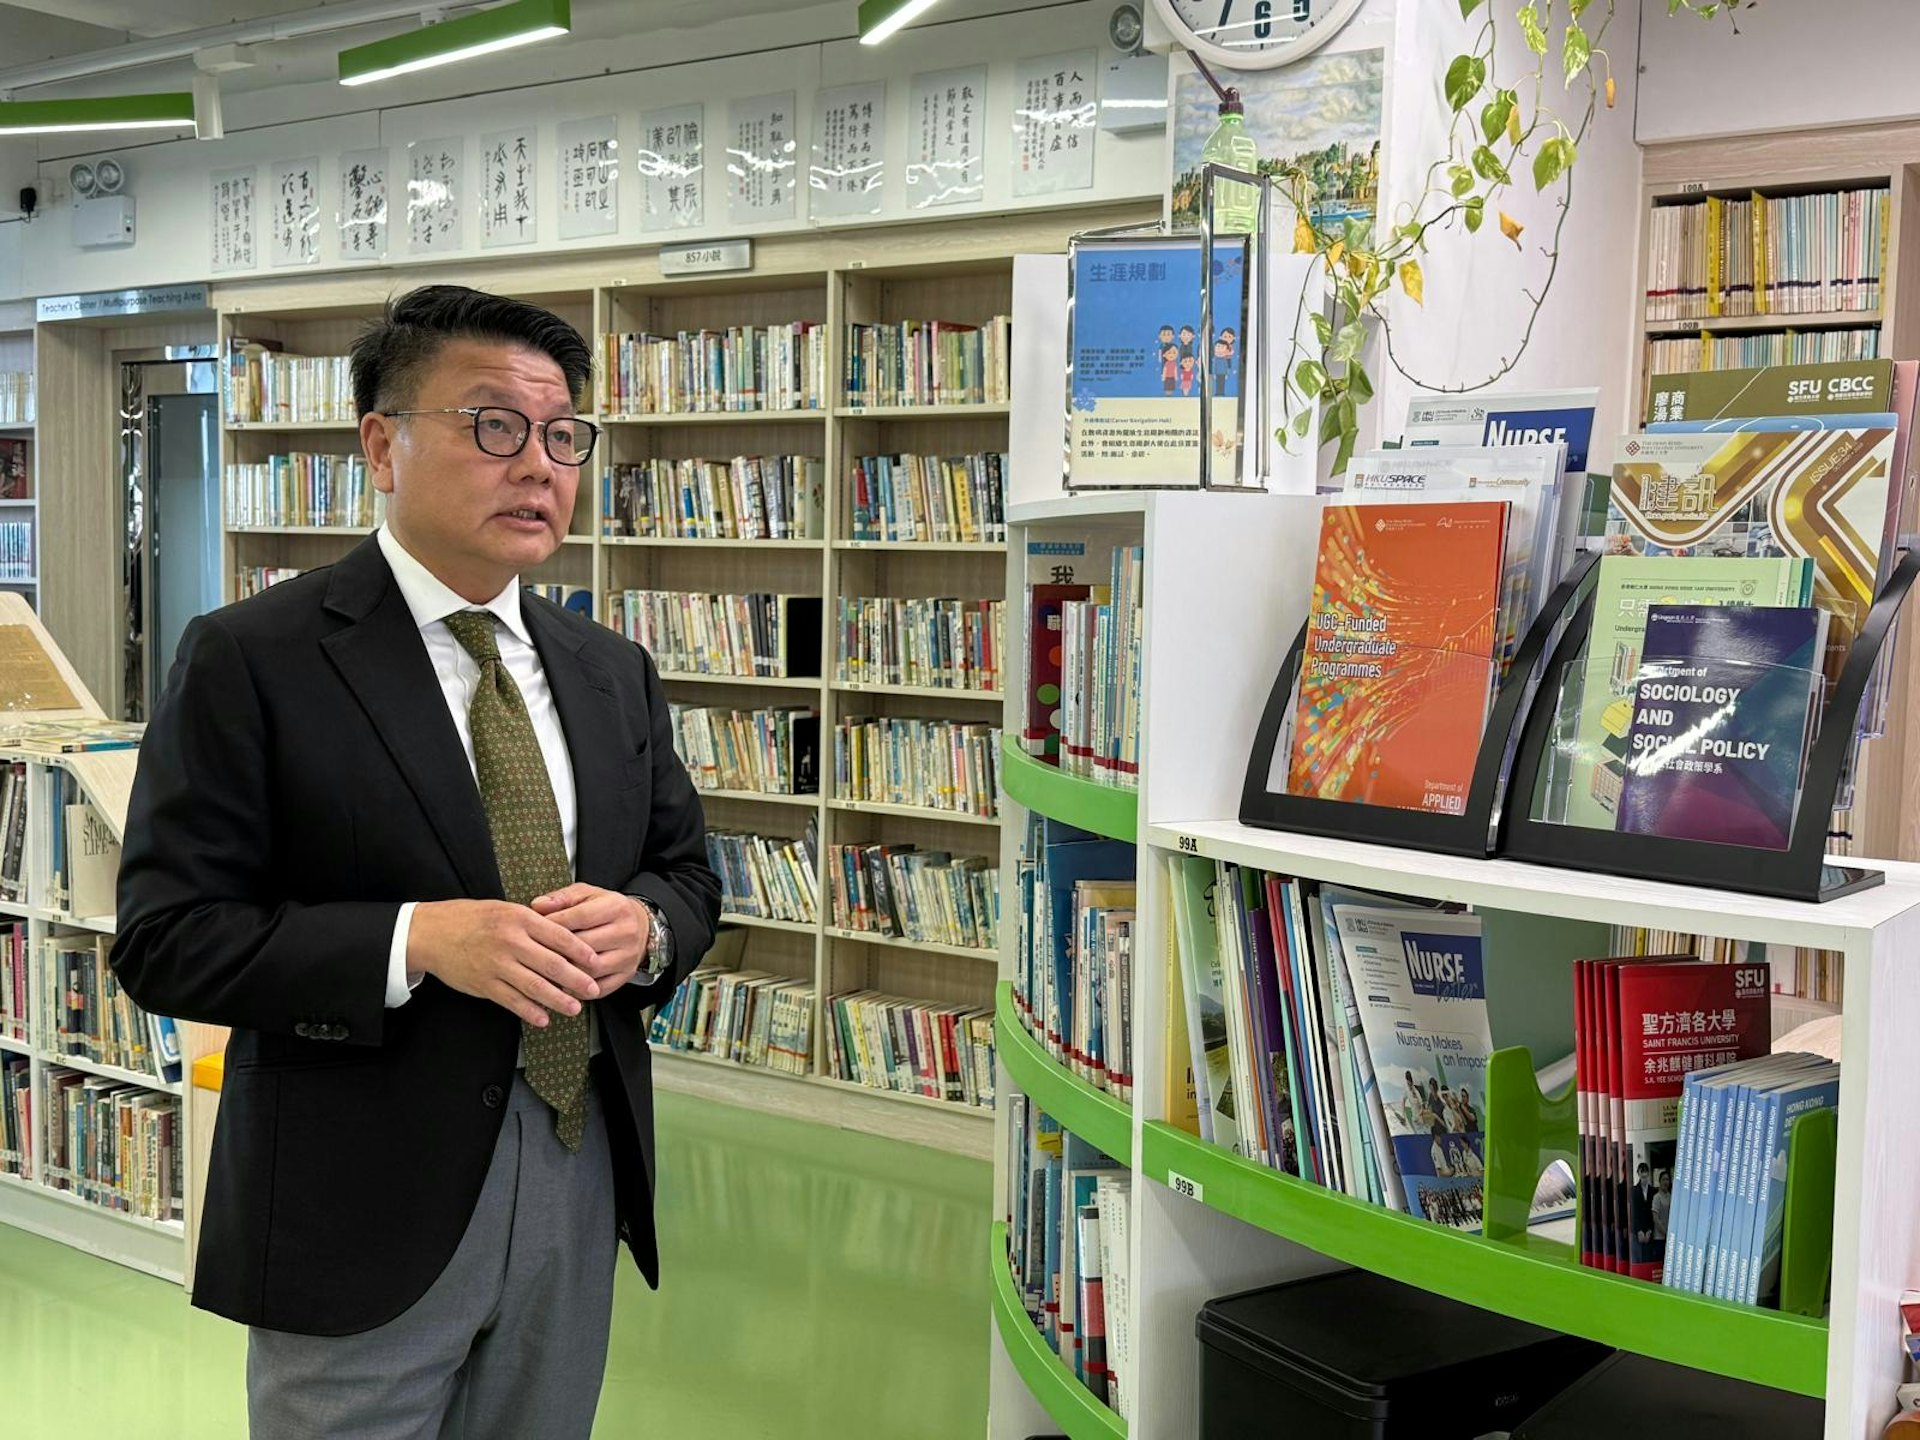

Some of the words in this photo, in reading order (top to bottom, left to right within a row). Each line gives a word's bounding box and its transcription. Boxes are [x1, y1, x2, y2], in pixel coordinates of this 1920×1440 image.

[1254, 1, 1271, 38] 6
[1089, 262, 1167, 282] 生涯規劃
[1788, 379, 1822, 396] SFU
[1828, 376, 1875, 393] CBCC
[1809, 452, 1840, 485] ISSUE
[1051, 565, 1075, 585] 我
[1316, 612, 1388, 633] UGC-Funded
[1314, 636, 1398, 657] Undergraduate
[1310, 658, 1382, 680] Programmes
[1697, 667, 1708, 678] of
[1639, 683, 1741, 704] SOCIOLOGY
[1636, 709, 1675, 726] AND
[1632, 733, 1696, 755] SOCI
[1701, 739, 1770, 761] POLICY
[1424, 779, 1457, 791] Department
[1422, 793, 1462, 811] APPLIED
[1178, 836, 1199, 853] 99A
[1404, 940, 1466, 983] NURSE
[1735, 968, 1765, 989] SFU
[1642, 1008, 1737, 1036] 聖方濟各大學
[1395, 1031, 1432, 1051] Nursing
[1432, 1034, 1464, 1051] Makes
[1643, 1038, 1665, 1049] SAINT
[1667, 1036, 1699, 1047] FRANCIS
[1700, 1034, 1740, 1046] UNIVERSITY
[1443, 1056, 1457, 1067] an
[1786, 1101, 1805, 1114] HONG
[1784, 1115, 1796, 1128] DES
[1174, 1177, 1196, 1197] 99B
